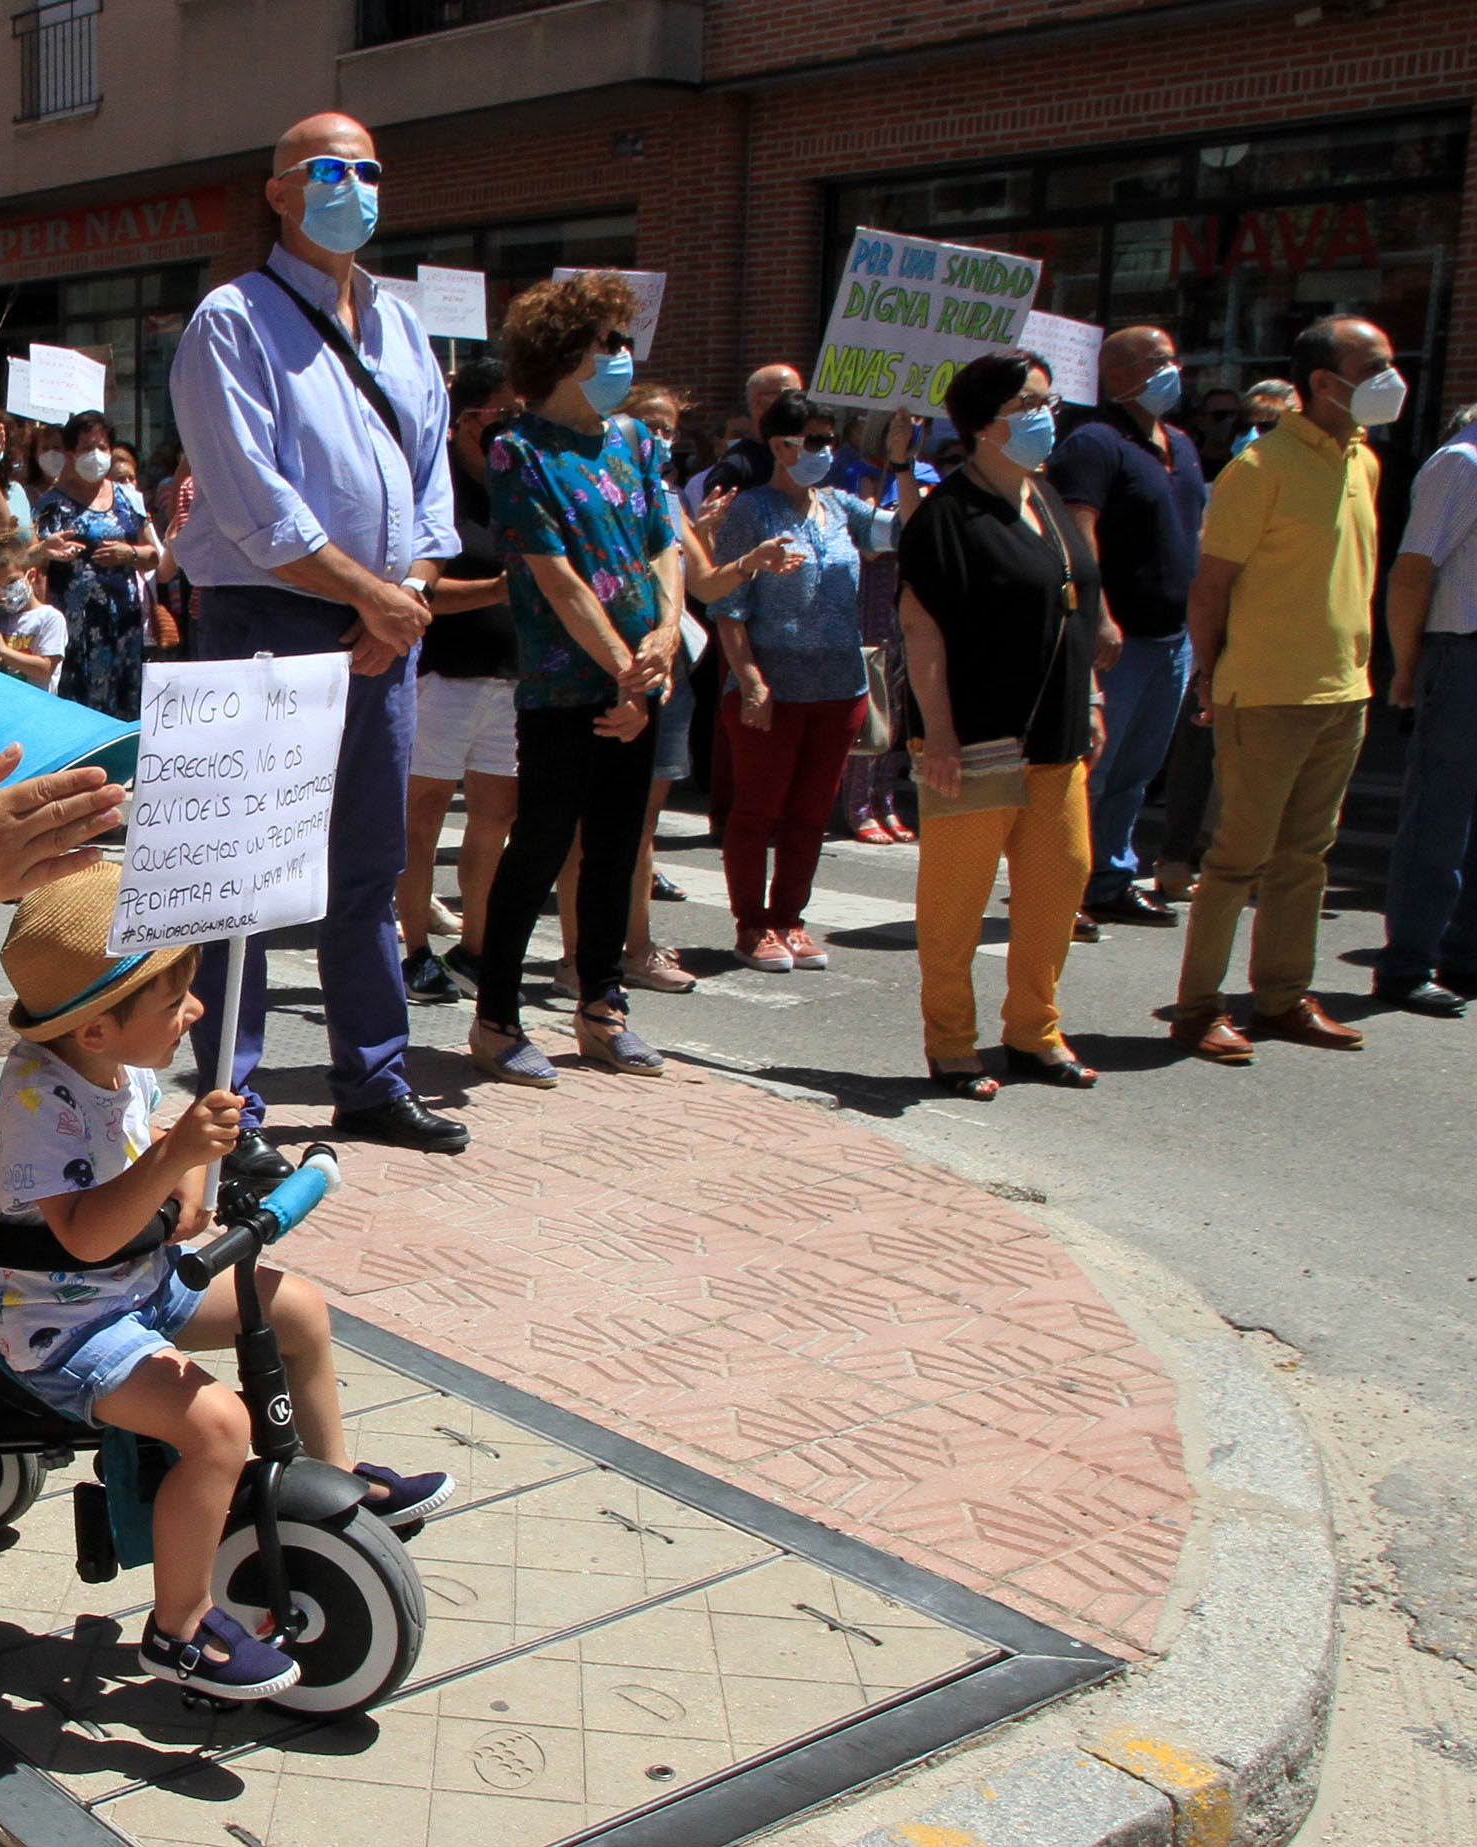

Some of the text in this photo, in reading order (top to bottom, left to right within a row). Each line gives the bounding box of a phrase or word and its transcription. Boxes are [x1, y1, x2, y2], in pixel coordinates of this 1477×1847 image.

[85, 198, 200, 247] NAVA
[1168, 203, 1379, 282] NAVA
[850, 238, 1035, 300] POR UNA SANIDAD
[842, 280, 1017, 345] DIGNA RURAL
[816, 344, 905, 399] NAVAS
[901, 362, 933, 398] DE
[145, 681, 298, 737] TENGO MIS
[140, 743, 302, 784] DERECHOS, NO OS
[136, 796, 231, 827] OLVIDEIS
[244, 793, 268, 816] DE
[131, 839, 240, 872] QUEREMOS
[246, 836, 265, 855] UN
[119, 881, 213, 920] PEDIATRA
[219, 879, 243, 899] EN
